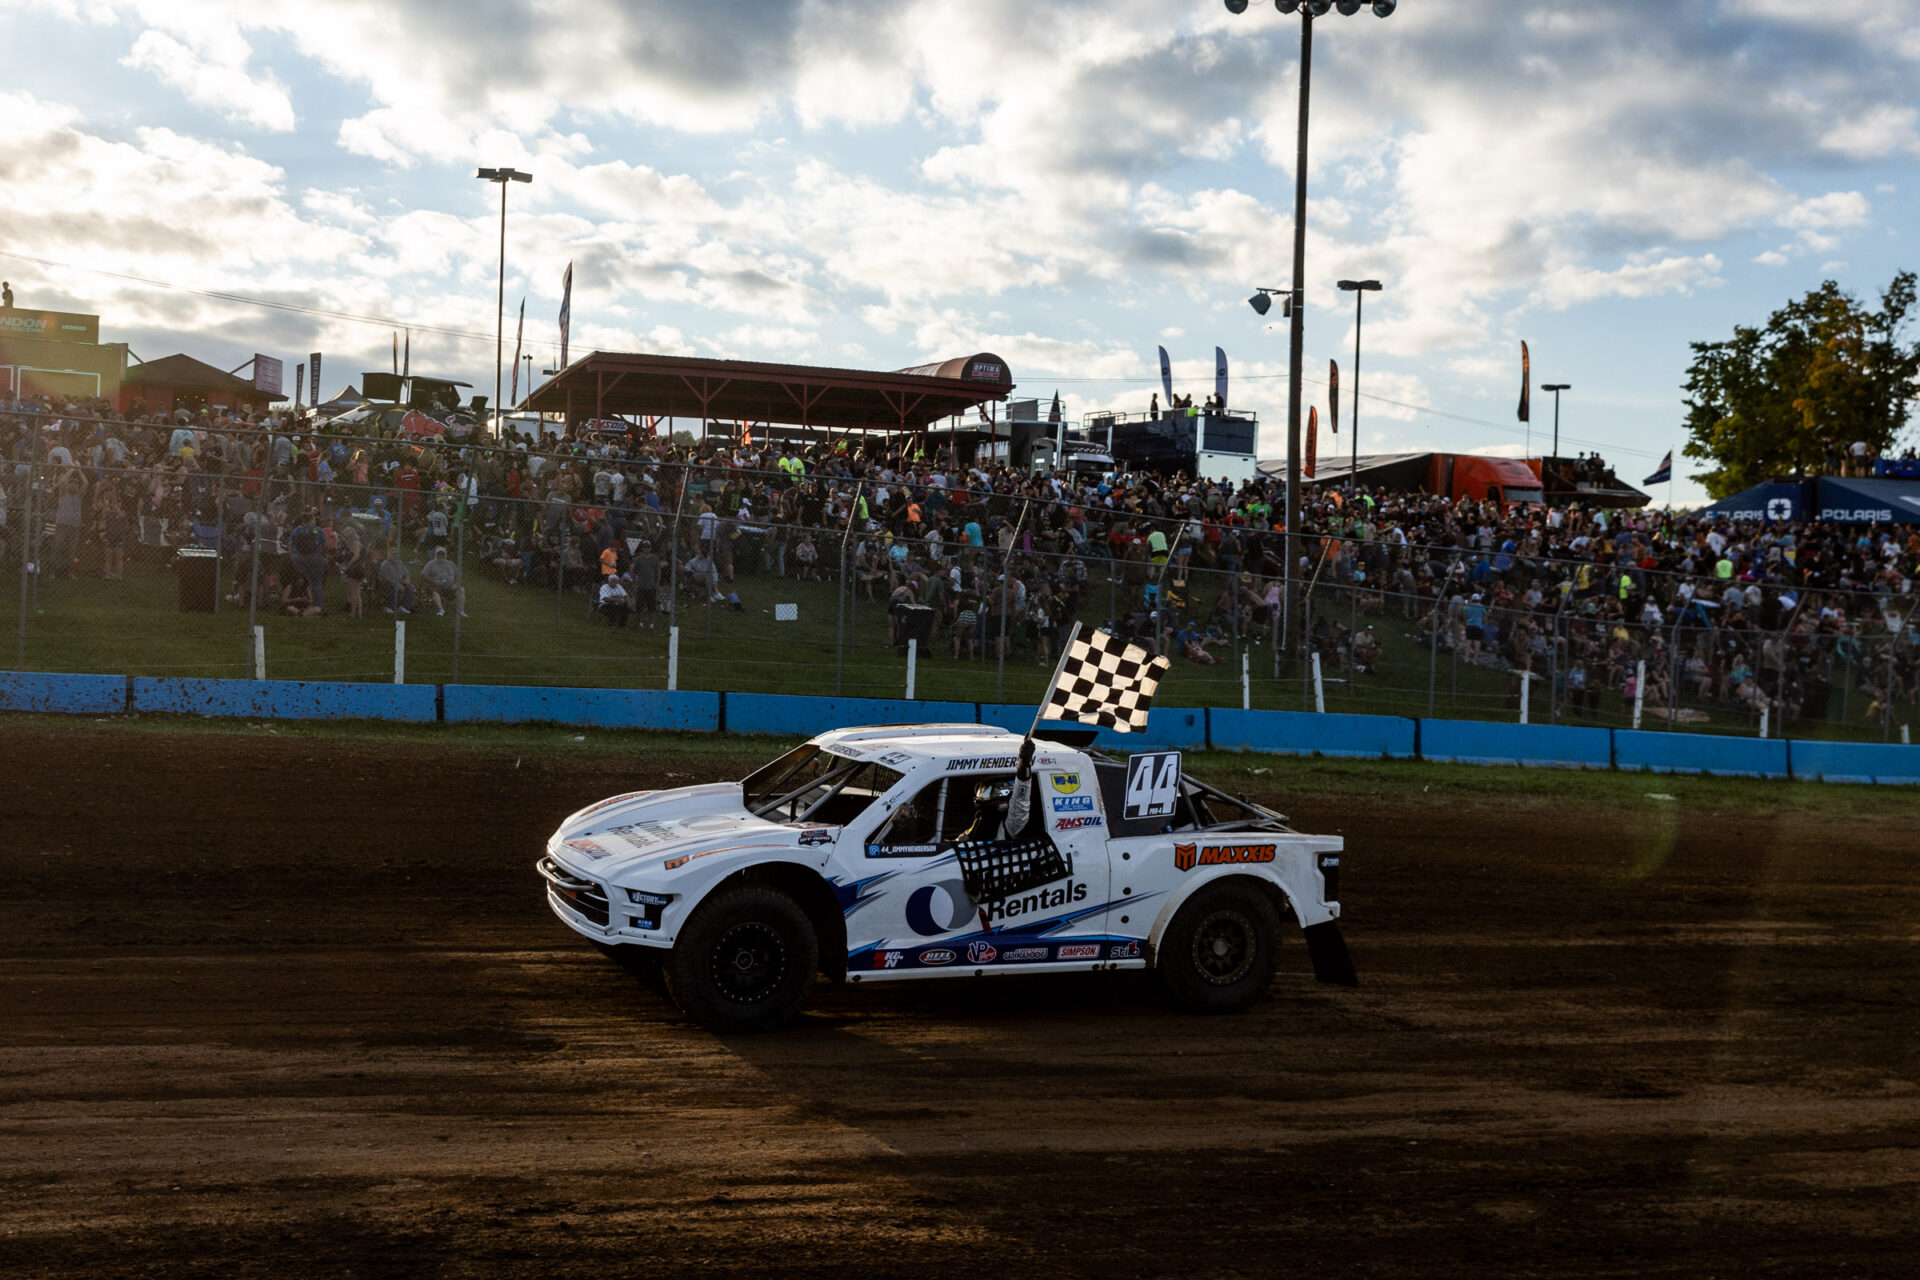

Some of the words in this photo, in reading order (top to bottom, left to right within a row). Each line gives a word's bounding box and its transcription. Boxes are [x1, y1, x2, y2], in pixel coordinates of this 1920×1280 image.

[1821, 509, 1892, 521] POLARIS
[946, 759, 989, 770] JIMMY
[1054, 775, 1078, 785] WD-40
[1127, 754, 1178, 816] 44
[1055, 796, 1091, 806] KING
[1055, 817, 1102, 830] AMSOIL
[1198, 845, 1277, 865] MAXXIS
[988, 880, 1087, 921] Rentals
[970, 942, 988, 962] VP
[1061, 946, 1096, 957] SIMPSON
